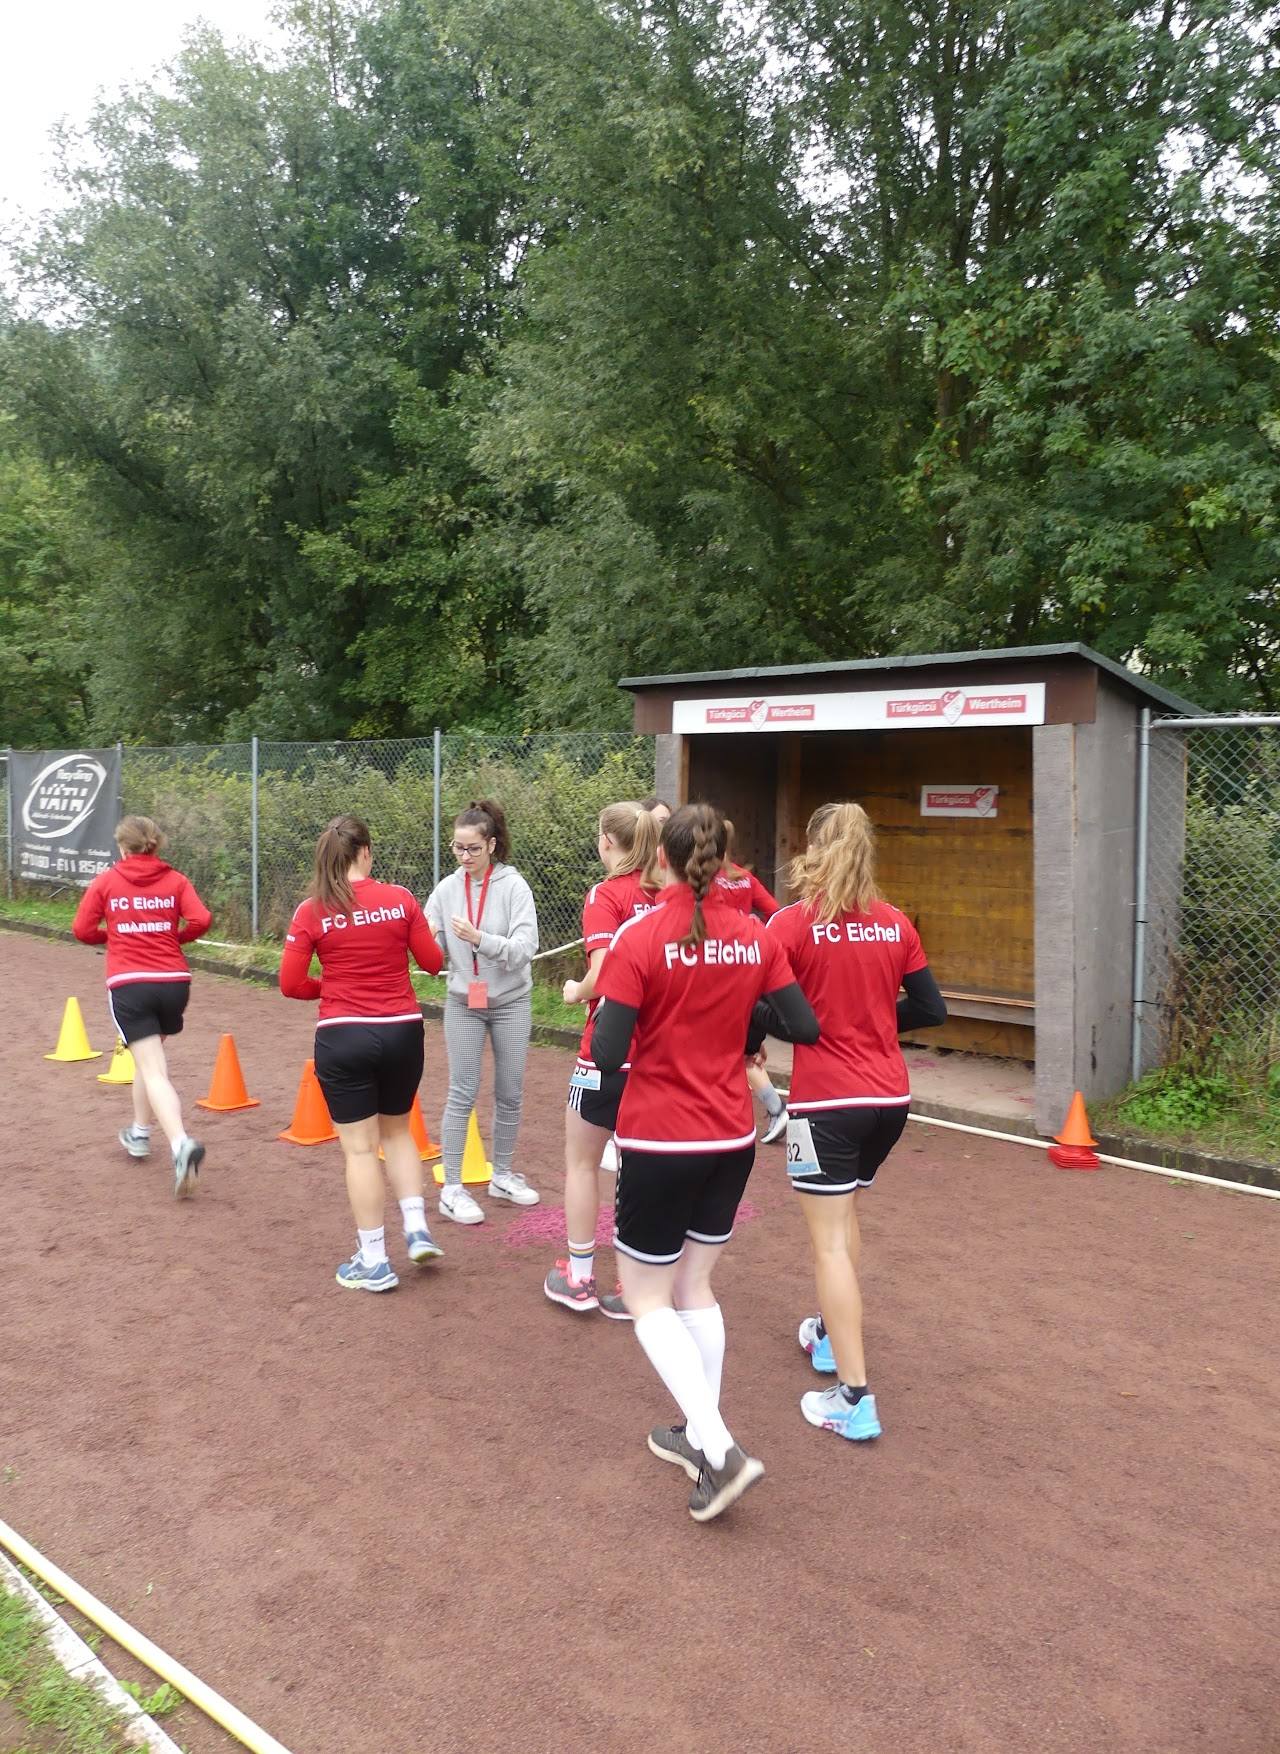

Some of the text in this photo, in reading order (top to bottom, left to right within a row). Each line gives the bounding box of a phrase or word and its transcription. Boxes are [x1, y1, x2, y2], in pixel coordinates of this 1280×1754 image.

[890, 698, 1022, 714] Türkgücü Wertheim
[110, 895, 175, 912] FC Eichel
[321, 904, 405, 933] FC Eichel
[812, 922, 901, 945] FC Eichel
[664, 938, 761, 969] FC Eichel
